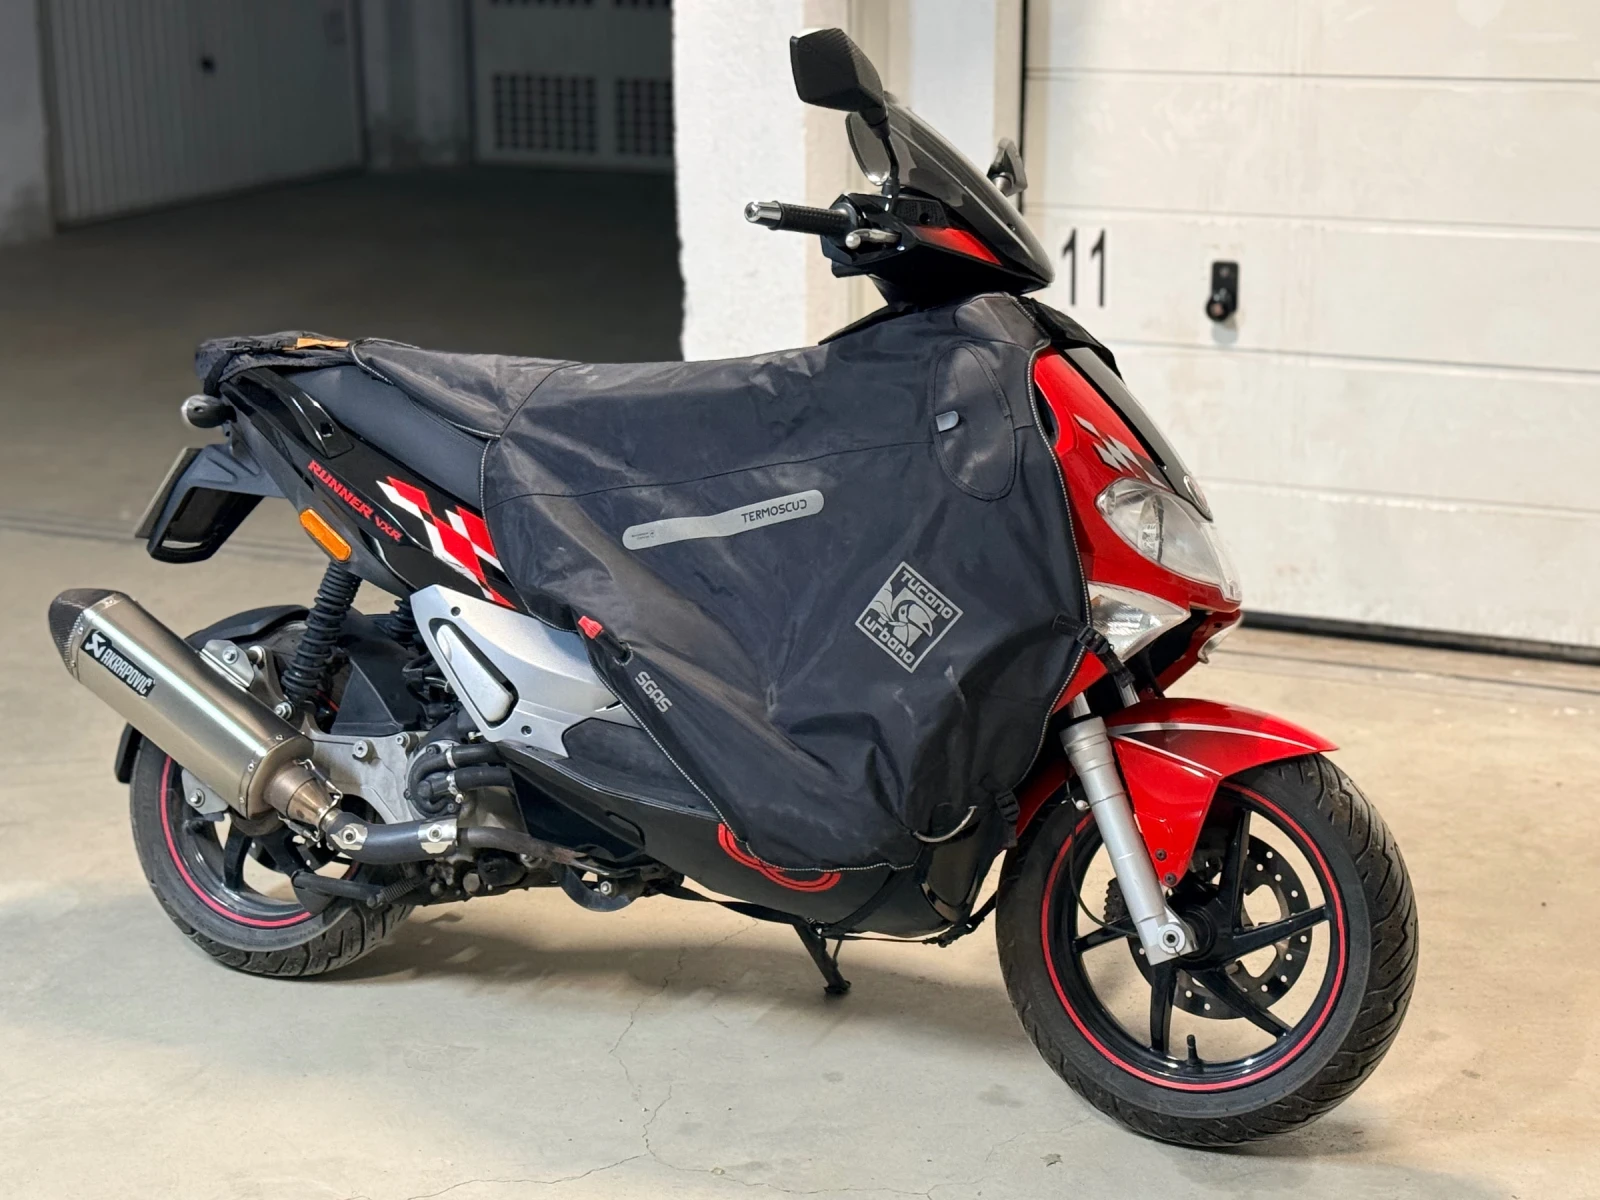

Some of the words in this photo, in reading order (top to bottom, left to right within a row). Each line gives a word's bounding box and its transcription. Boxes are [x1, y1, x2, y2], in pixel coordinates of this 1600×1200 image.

[1061, 227, 1106, 308] 11
[308, 459, 374, 520] RUNNER
[374, 515, 403, 542] VXR
[740, 498, 808, 524] TERMOSCUD
[863, 615, 916, 664] urbano
[634, 671, 673, 713] SGAS
